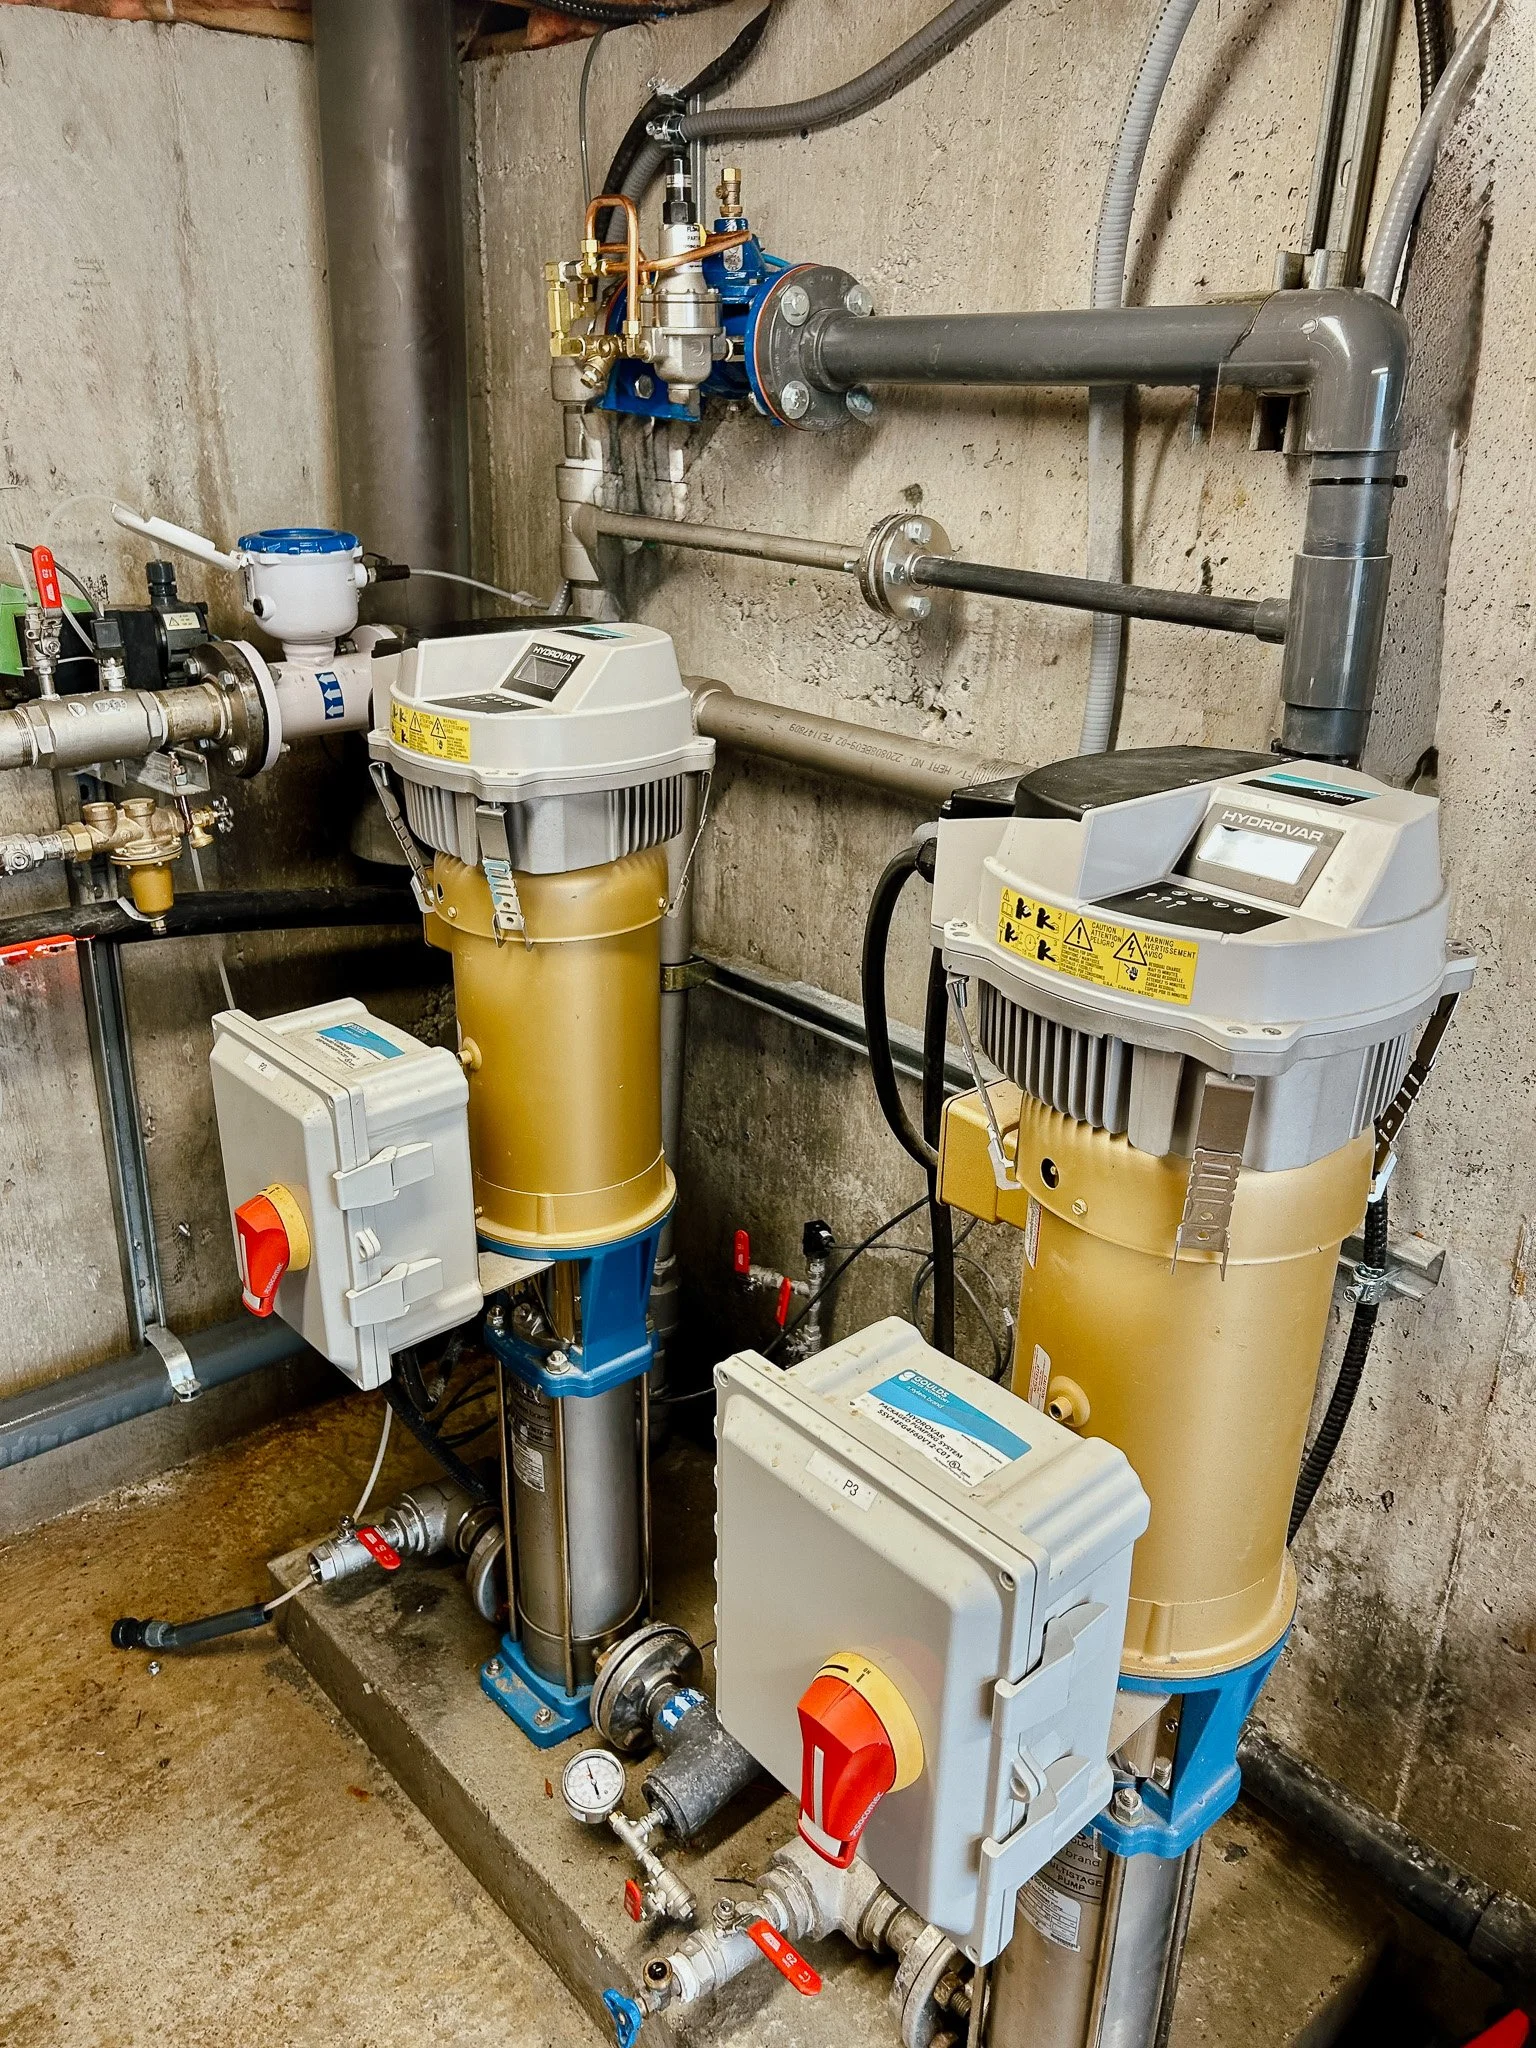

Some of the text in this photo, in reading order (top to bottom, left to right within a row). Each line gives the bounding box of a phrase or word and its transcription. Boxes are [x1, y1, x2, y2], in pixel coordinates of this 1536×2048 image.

[533, 646, 577, 663] HYDROVAR
[928, 761, 952, 775] HEAT
[1313, 789, 1356, 803] xylem
[1221, 810, 1325, 842] HYDROVAR
[1091, 921, 1117, 934] CAUTION
[1089, 935, 1115, 949] PELIGRO
[1090, 929, 1122, 943] ATTENTION
[1144, 935, 1174, 948] WARNING
[1142, 942, 1197, 959] AVERTISSEMENT
[1143, 949, 1164, 960] AVISO
[258, 1061, 268, 1073] P2
[914, 1376, 950, 1398] GOULDS
[927, 1396, 945, 1409] brand
[879, 1402, 963, 1459] PACKAGED PUMPING SYSTEM
[905, 1412, 946, 1440] HYDROVAR
[842, 1480, 860, 1497] P3
[853, 1791, 884, 1832] socomec
[1064, 1848, 1101, 1868] brand
[1051, 1861, 1103, 1888] ULTISTAGE
[1058, 1875, 1086, 1891] PUMP
